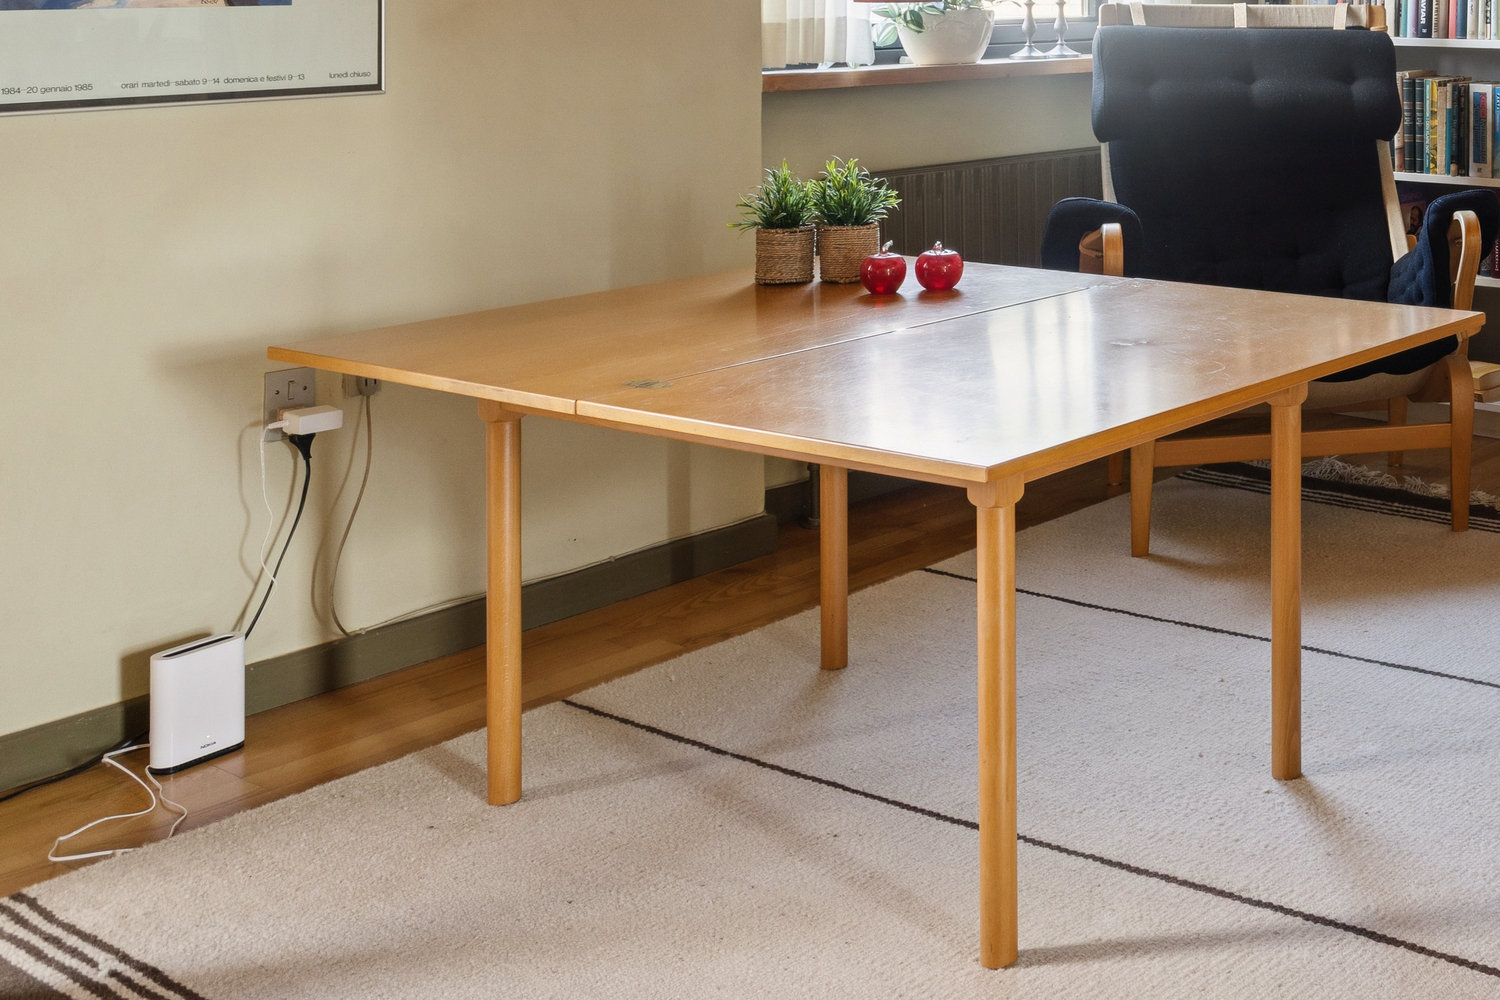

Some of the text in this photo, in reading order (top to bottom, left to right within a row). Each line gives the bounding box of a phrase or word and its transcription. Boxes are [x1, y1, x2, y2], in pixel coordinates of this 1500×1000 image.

[224, 75, 259, 84] domenica
[266, 73, 286, 82] festivi
[350, 70, 371, 78] chiuso
[40, 84, 73, 95] gennaio
[74, 83, 94, 92] 1985
[121, 80, 139, 90] orari
